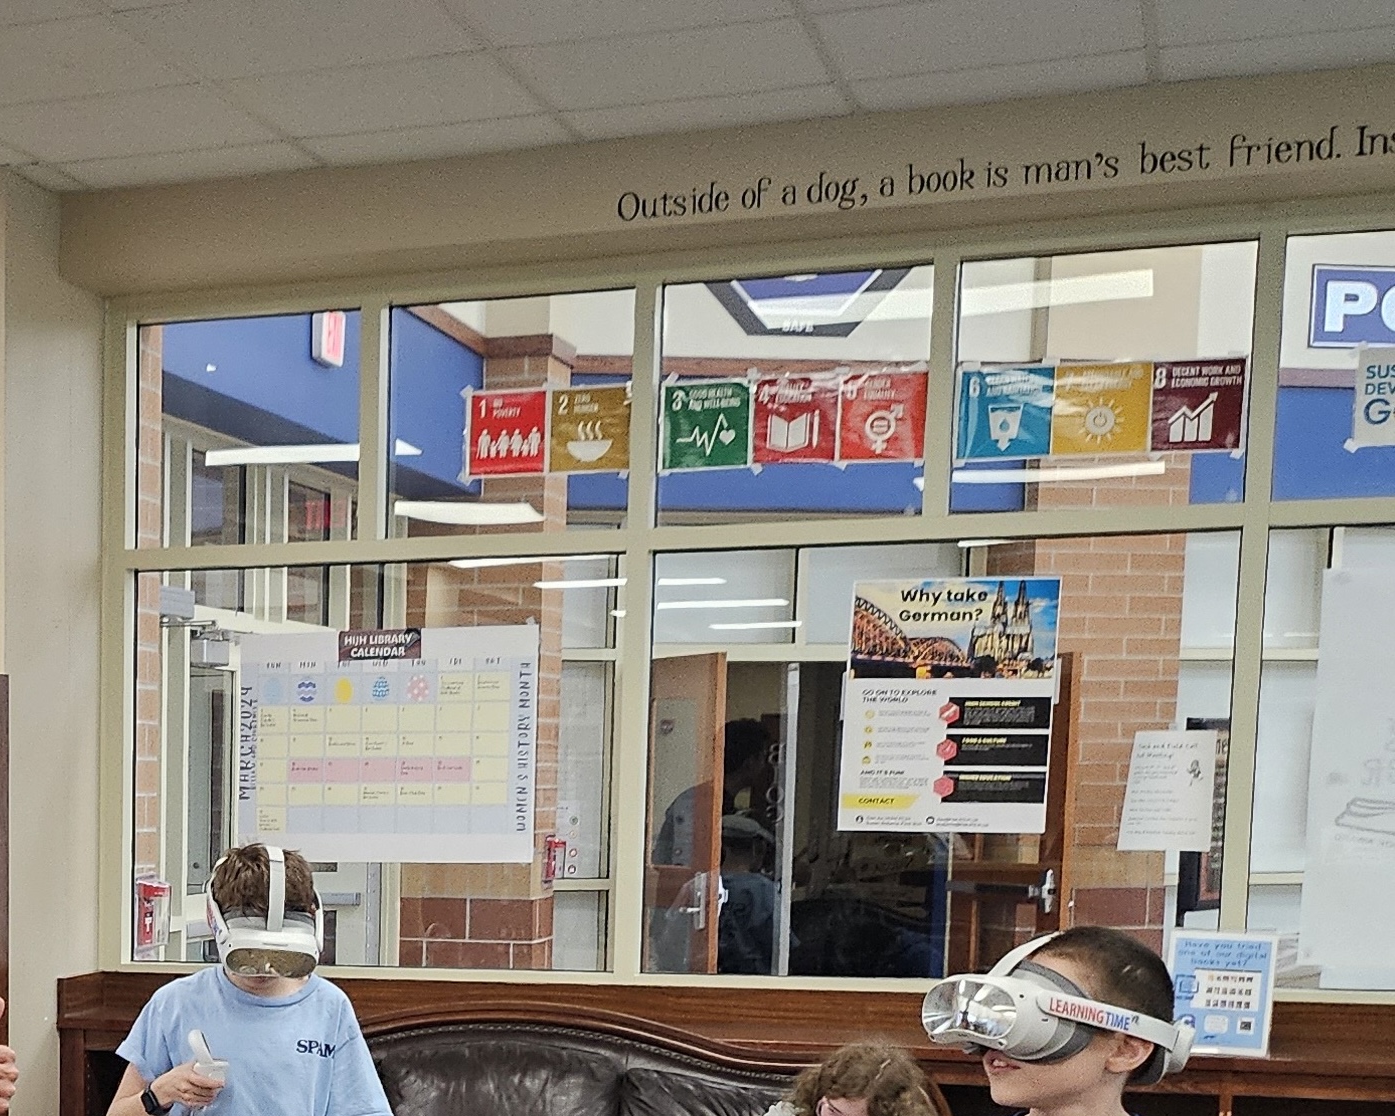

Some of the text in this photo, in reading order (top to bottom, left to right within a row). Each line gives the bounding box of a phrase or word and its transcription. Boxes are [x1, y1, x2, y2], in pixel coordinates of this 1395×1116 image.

[618, 181, 729, 222] Outside
[741, 177, 771, 209] of
[782, 189, 796, 205] a
[807, 171, 868, 210] dog,
[879, 176, 894, 197] a
[907, 157, 975, 195] book
[984, 161, 1008, 188] is
[1024, 152, 1119, 185] man's
[1138, 142, 1211, 175] best
[1228, 125, 1341, 168] friend.
[1323, 280, 1395, 334] P
[1155, 368, 1166, 388] 8
[1172, 365, 1241, 376] DECENT WORK AND
[1171, 375, 1242, 388] ECONOMIC GROWTH
[479, 399, 486, 418] 1
[558, 394, 569, 416] 2
[672, 390, 683, 411] 3
[1364, 398, 1395, 425] G
[901, 588, 988, 607] Why take
[899, 608, 983, 621] German?
[369, 632, 413, 645] LIBRARY
[350, 646, 406, 658] CALENDAR
[1200, 949, 1211, 957] of
[1236, 950, 1267, 960] digital
[1237, 942, 1262, 950] tried
[296, 1039, 337, 1059] SPAM
